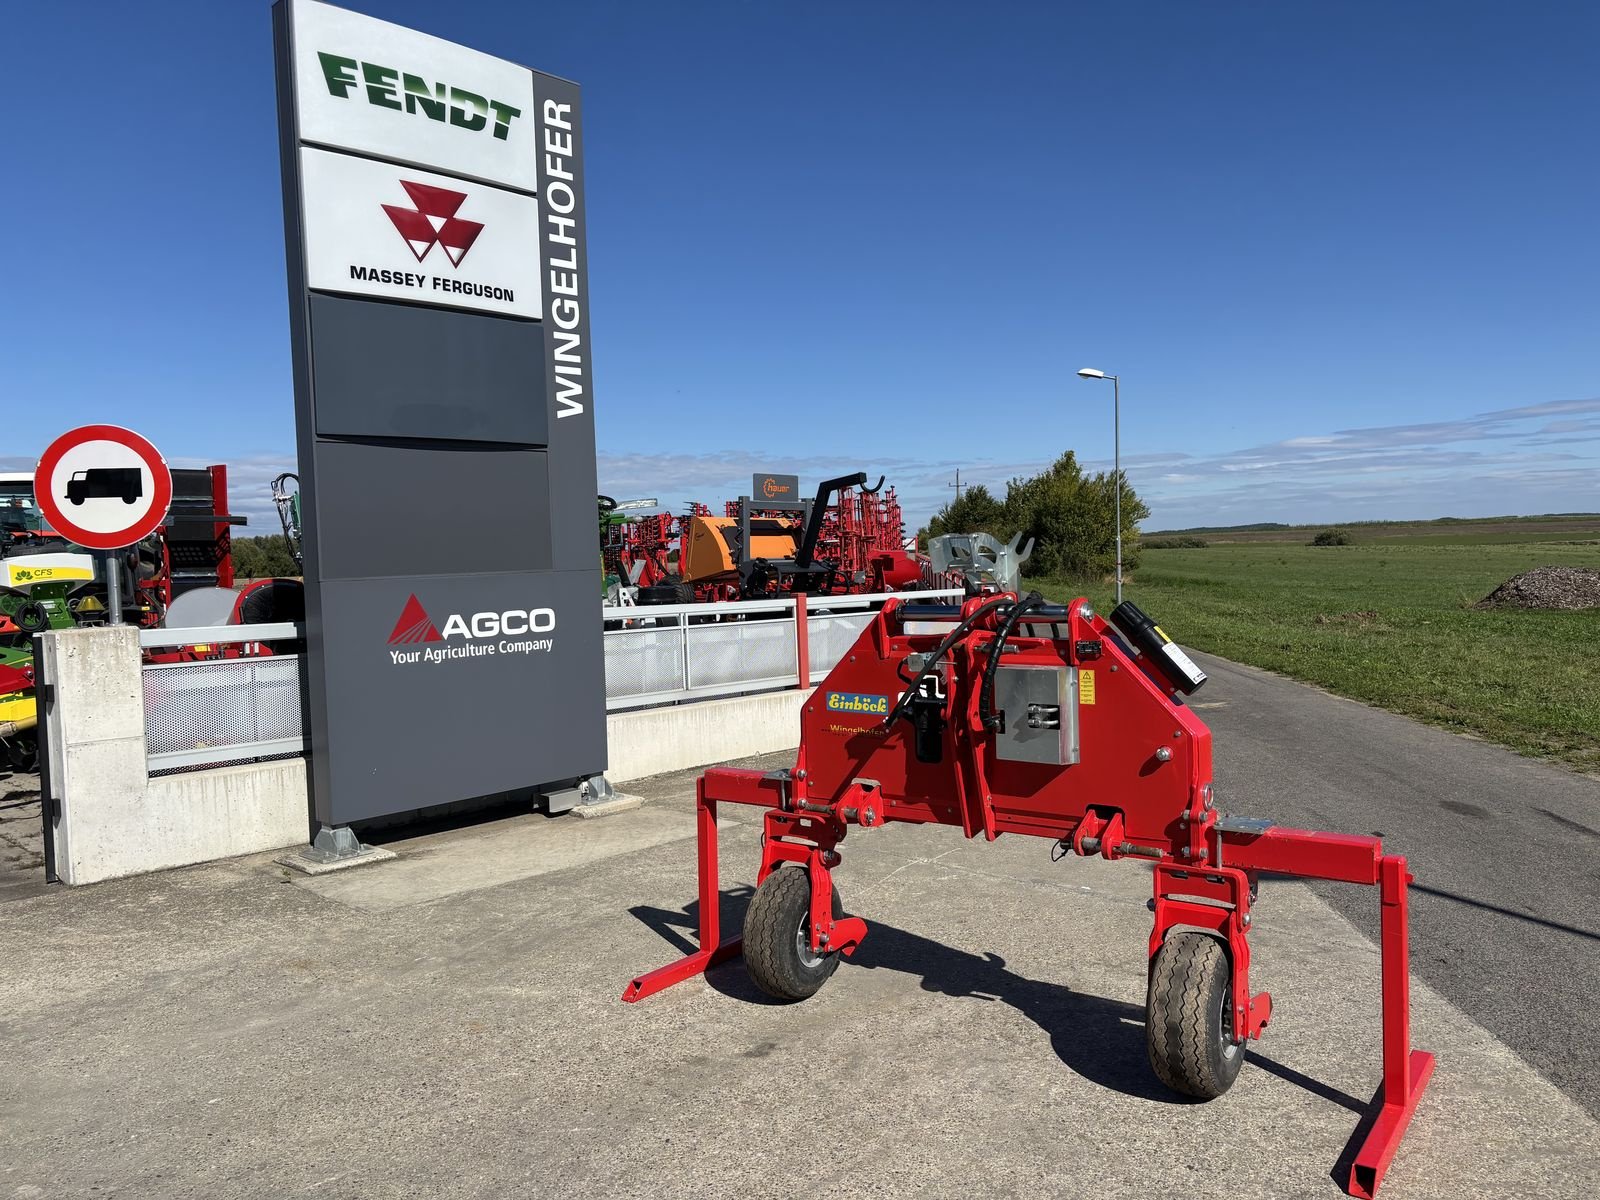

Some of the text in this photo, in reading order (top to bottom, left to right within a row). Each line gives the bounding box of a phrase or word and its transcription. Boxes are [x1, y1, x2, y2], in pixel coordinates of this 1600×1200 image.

[317, 51, 521, 141] FENDT
[544, 99, 583, 418] WINGELHOFER
[350, 265, 515, 302] MASSEY FERGUSON
[34, 568, 52, 576] CFS
[442, 607, 555, 640] AGCO
[390, 638, 553, 665] Your Agriculture Company
[828, 693, 886, 712] Einböck
